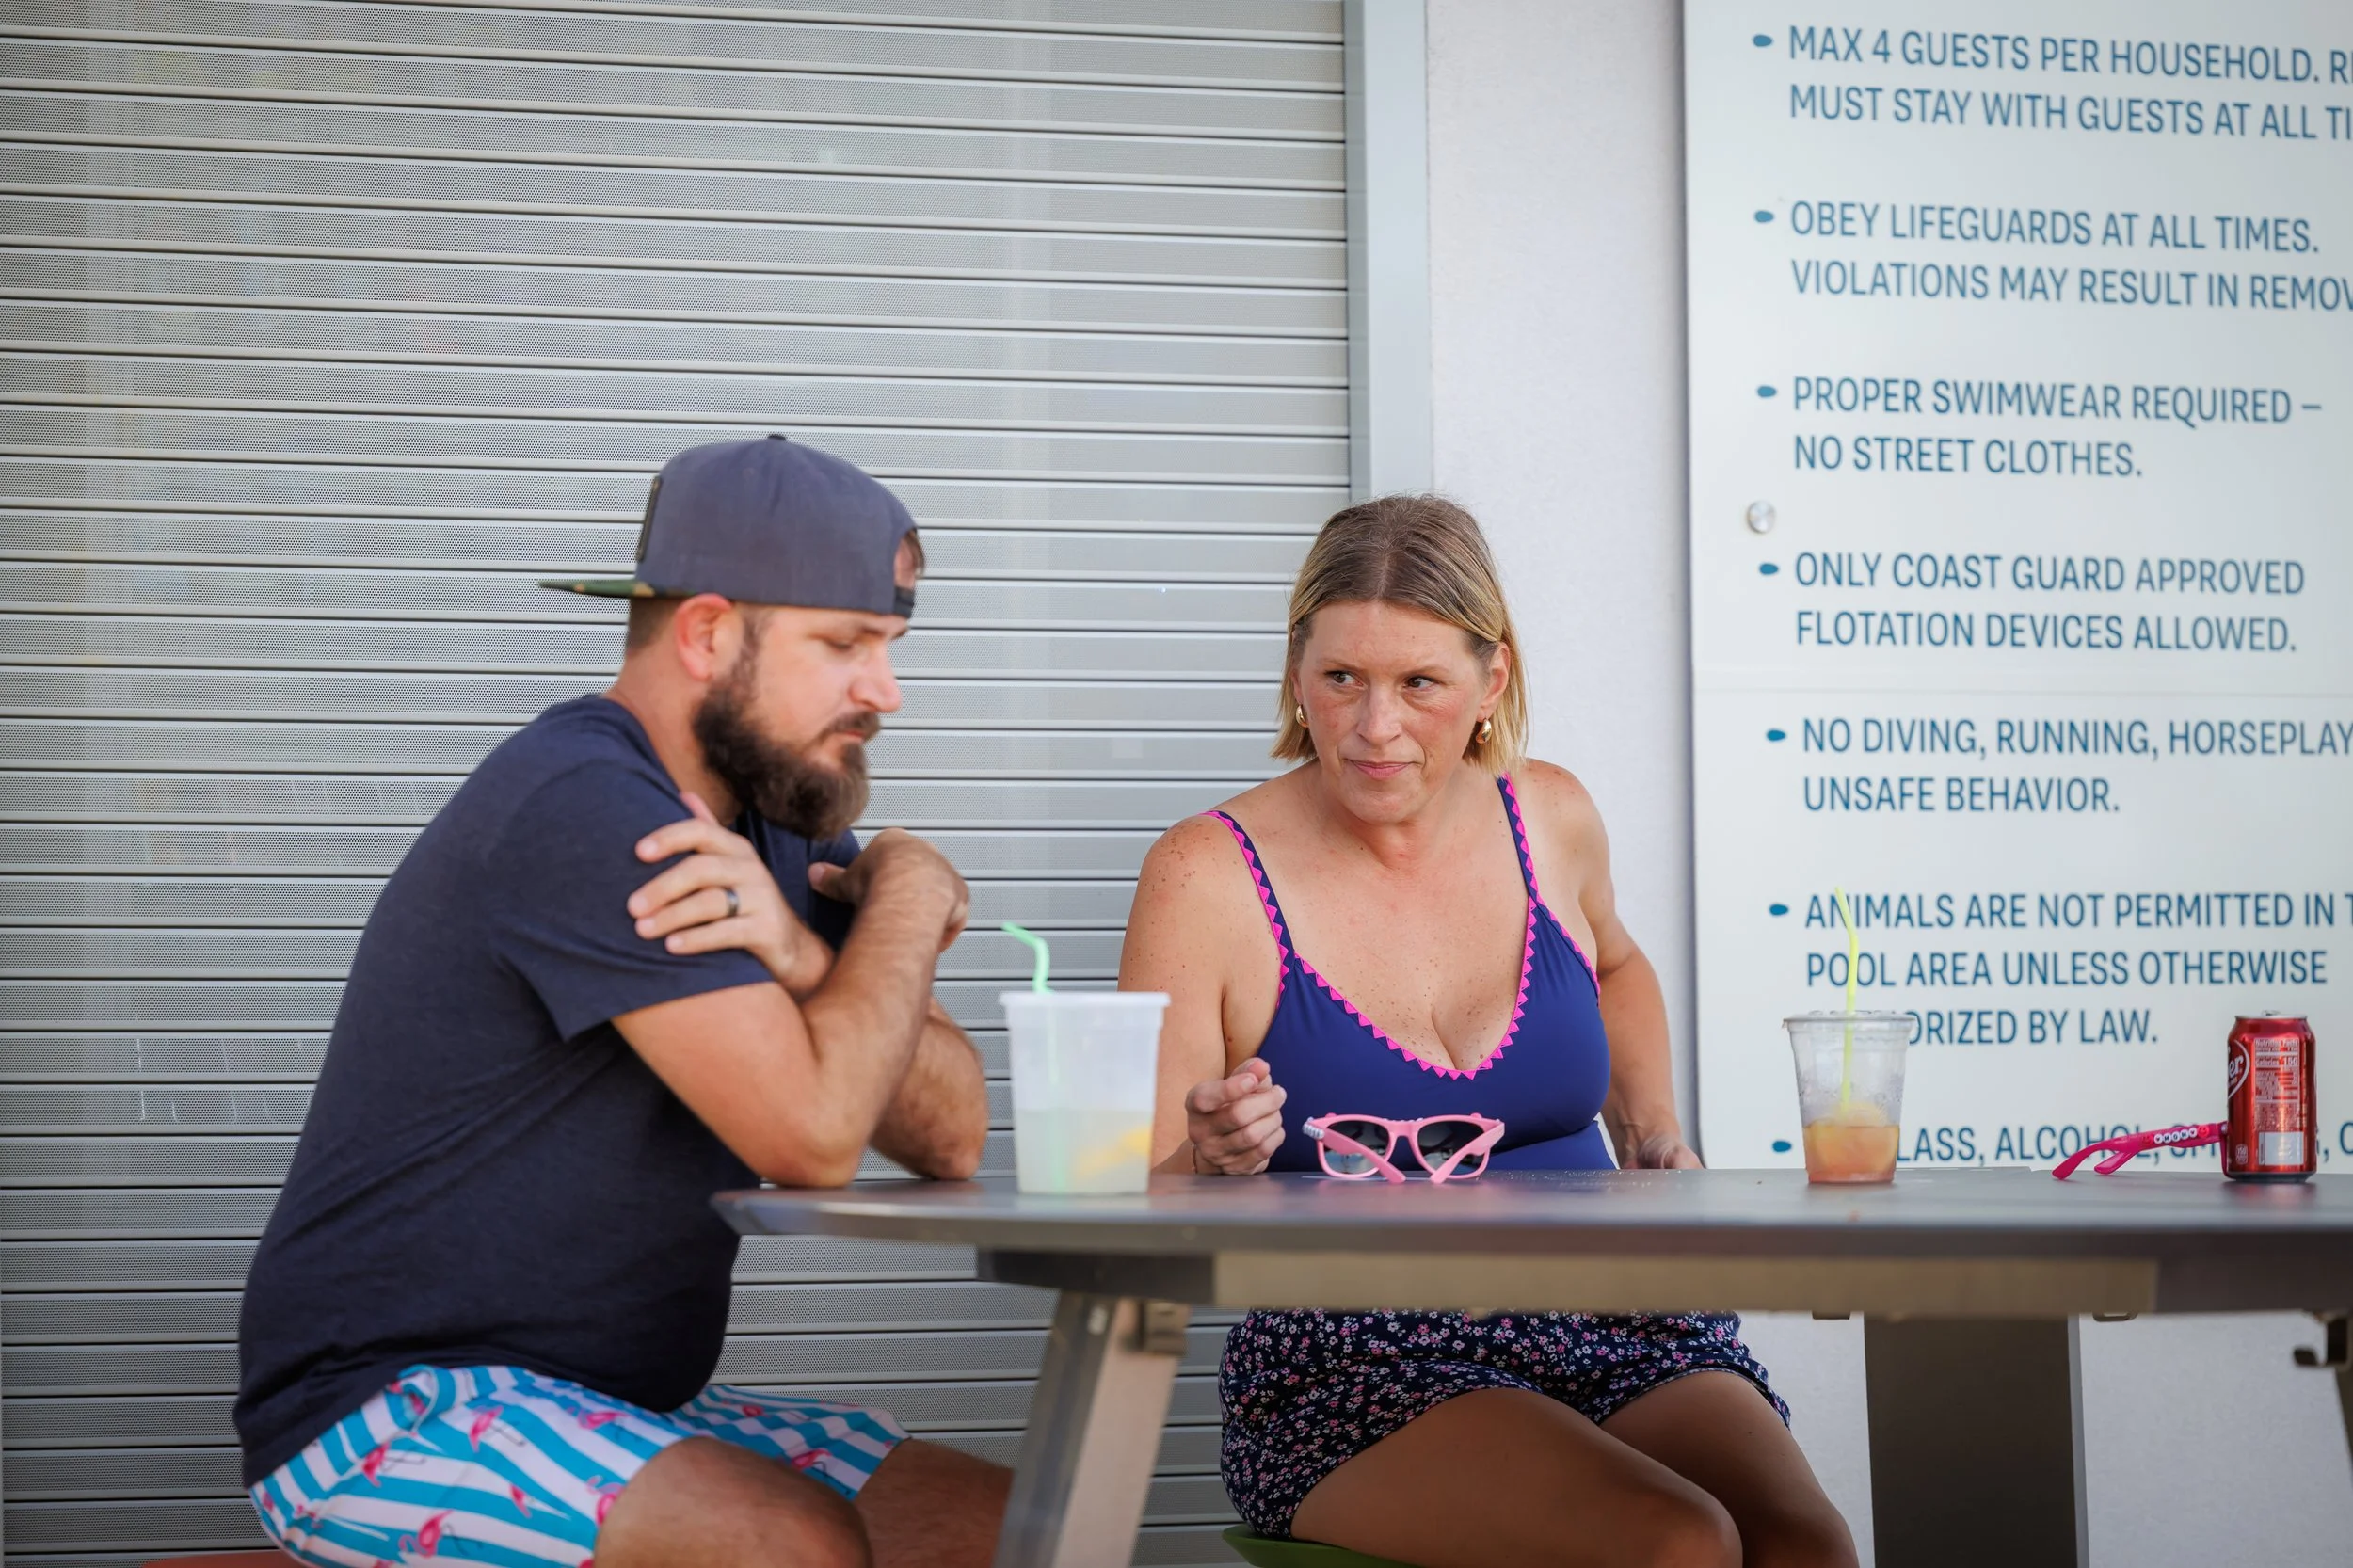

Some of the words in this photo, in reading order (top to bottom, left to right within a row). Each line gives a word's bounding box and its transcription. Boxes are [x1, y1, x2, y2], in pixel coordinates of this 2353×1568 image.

[1790, 25, 1863, 62] MAX
[1872, 29, 1891, 63] 4
[1901, 30, 2029, 71] GUESTS
[2041, 37, 2100, 72] PER
[2111, 40, 2319, 82] HOUSEHOLD.
[2330, 50, 2353, 85] R
[1791, 84, 1883, 120] MUST
[1894, 88, 1971, 124] STAY
[1982, 92, 2066, 129] WITH
[2077, 96, 2203, 135] GUESTS
[2214, 103, 2251, 136] AT
[2261, 104, 2317, 139] ALL
[1791, 200, 1879, 237] OBEY
[1892, 205, 2091, 246] LIFEGUARDS
[2102, 213, 2139, 246] AT
[2149, 215, 2206, 249] ALL
[2214, 216, 2318, 253] TIMES.
[1792, 260, 1989, 299] VIOLATIONS
[2000, 266, 2068, 301] MAY
[2079, 268, 2198, 305] RESULT
[2208, 273, 2238, 307] IN
[1794, 376, 1922, 413] PROPER
[1932, 379, 2121, 419] SWIMWEAR
[2133, 385, 2291, 429] REQUIRED
[1795, 435, 1843, 470] NO
[1853, 436, 1975, 472] STREET
[1984, 439, 2142, 476] CLOTHES.
[1795, 552, 1881, 587] ONLY
[1892, 553, 2003, 589] COAST
[2011, 555, 2125, 592] GUARD
[2136, 558, 2304, 595] APPROVED
[1797, 610, 1974, 647] FLOTATION
[1986, 613, 2123, 649] DEVICES
[2133, 616, 2297, 653] ALLOWED.
[1803, 718, 1851, 753] NO
[1863, 718, 1986, 760] DIVING,
[1997, 719, 2158, 760] RUNNING,
[1803, 776, 1935, 812] UNSAFE
[1946, 777, 2120, 812] BEHAVIOR.
[1805, 893, 1955, 928] ANIMALS
[1964, 893, 2027, 929] ARE
[2038, 893, 2105, 928] NOT
[2115, 892, 2294, 928] PERMITTED
[2304, 892, 2334, 927] IN
[1807, 952, 1897, 987] POOL
[1906, 952, 1993, 986] AREA
[2003, 951, 2129, 986] UNLESS
[2139, 950, 2327, 985] OTHERWISE
[1904, 1010, 2018, 1046] ORIZED
[2028, 1010, 2069, 1045] BY
[2080, 1009, 2157, 1044] LAW.
[1897, 1127, 1984, 1167] LASS,
